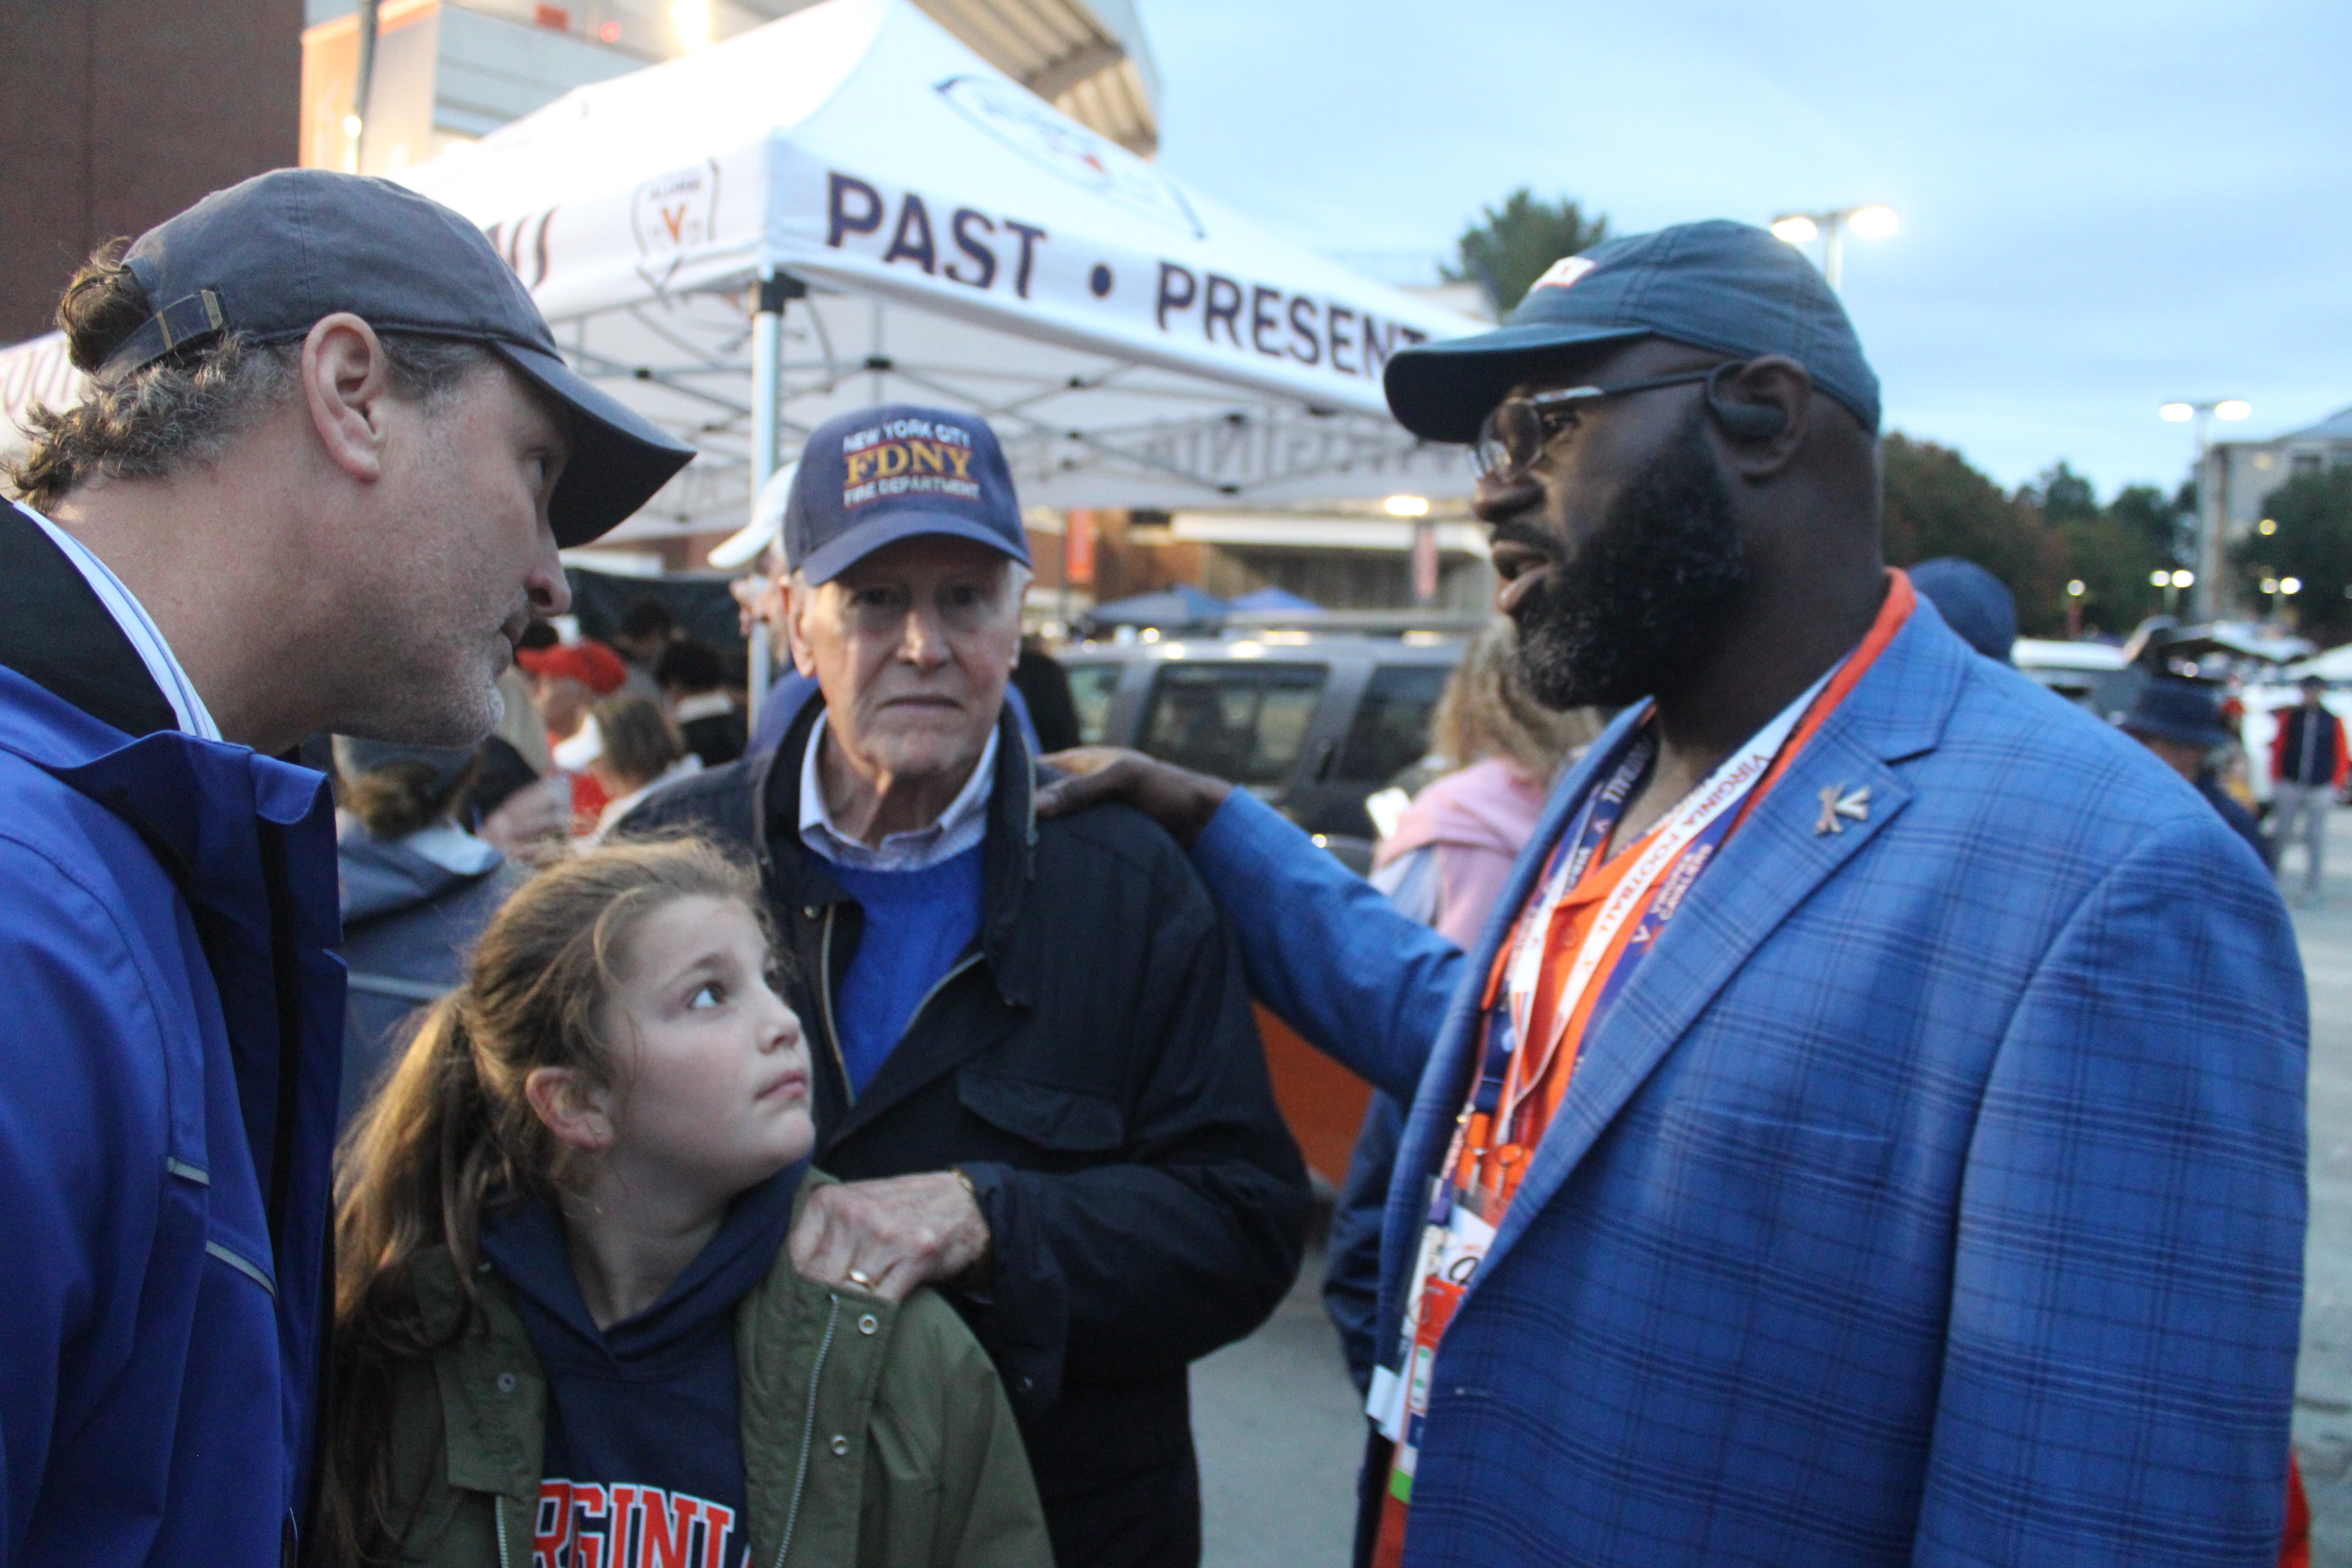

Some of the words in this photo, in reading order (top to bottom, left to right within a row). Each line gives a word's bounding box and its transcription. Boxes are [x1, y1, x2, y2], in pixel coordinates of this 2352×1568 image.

[826, 170, 1047, 300] PAST
[843, 428, 880, 453] NEW
[883, 418, 933, 440] YORK
[935, 424, 971, 449] CITY
[845, 440, 972, 484] FDNY
[843, 481, 876, 507] FIRE
[878, 475, 980, 500] DEPARTMENT
[1681, 752, 1771, 829] VIRGINIA
[1596, 833, 1679, 934] FOOTBALL
[533, 1478, 755, 1568] RGINI
